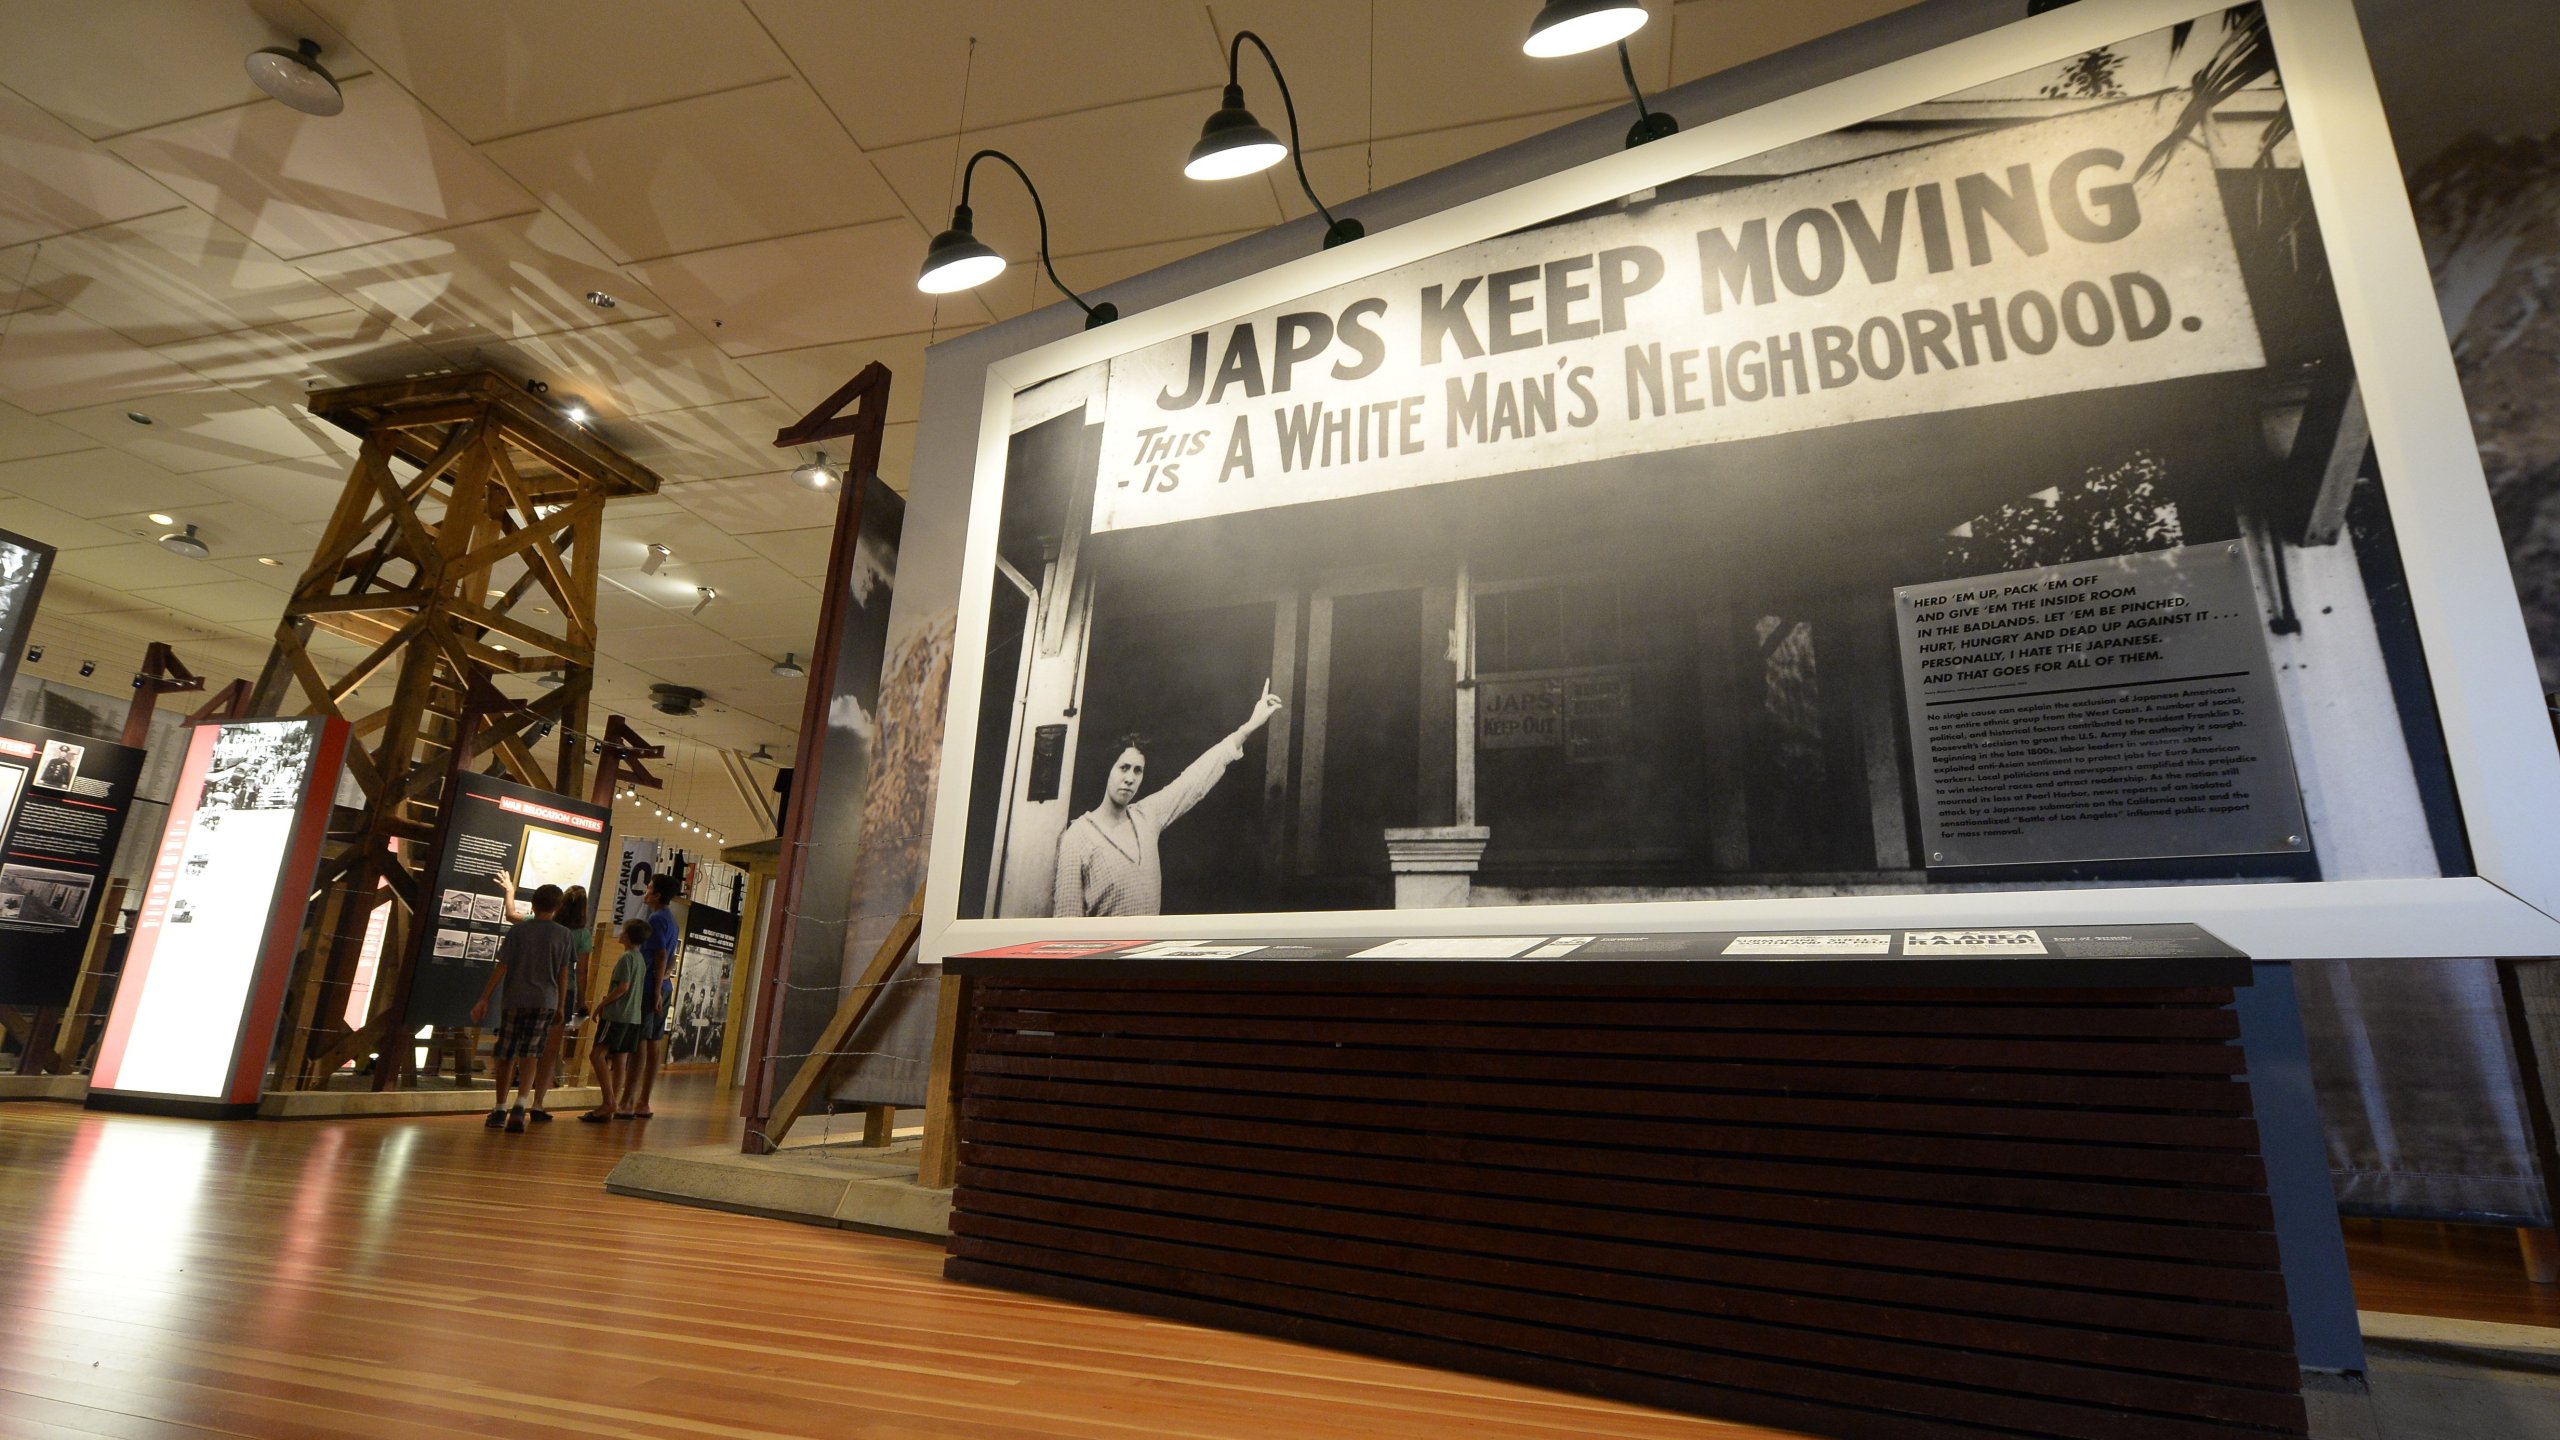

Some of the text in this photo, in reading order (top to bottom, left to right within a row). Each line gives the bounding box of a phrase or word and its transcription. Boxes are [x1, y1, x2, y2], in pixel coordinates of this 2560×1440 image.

[1156, 147, 2142, 411] JAPS KEEP MOVING
[1218, 271, 2202, 483] A WHITE MAN'S NEIGHBORHOOD.
[1134, 425, 1210, 466] THIS
[1913, 575, 2098, 609] HERD 'EM UP, PACK 'EM OFF
[1915, 586, 2136, 624] AND GIVE 'EM THE INSIDE ROOM
[1917, 597, 2190, 639] IN THE BADLANDS. LET 'EM BE PINCHED,
[1919, 610, 2209, 654] HURT, HUNGRY AND DEAD UP AGAINST IT
[1921, 633, 2163, 669] PERSONALLY, I HATE THE JAPANESE.
[1923, 650, 2164, 685] AND THAT GOES FOR ALL OF THEM.
[1487, 692, 1553, 712] JAPS
[1927, 713, 1941, 721] No
[1942, 711, 1969, 720] single
[1970, 709, 1997, 717] cause
[2017, 703, 2052, 713] explain
[2054, 701, 2070, 710] the
[2071, 697, 2117, 708] exclusion
[2119, 695, 2130, 703] of
[2131, 692, 2179, 703] Japanese
[2182, 687, 2237, 698] Americans
[1955, 721, 1981, 729] entire
[1982, 718, 2010, 727] ethnic
[2012, 716, 2041, 726] group
[2042, 713, 2066, 721] from
[2067, 711, 2083, 719] the
[2084, 709, 2110, 718] West
[2156, 701, 2196, 711] number
[2197, 699, 2209, 708] of
[1484, 715, 1556, 736] KEEP OUT
[1969, 730, 1988, 739] and
[1989, 726, 2031, 737] historical
[2033, 725, 2066, 733] factors
[2067, 718, 2123, 730] contributed
[2137, 714, 2185, 725] President
[2187, 709, 2230, 720] Franklin
[1981, 739, 2018, 749] decision
[2032, 736, 2059, 746] grant
[2060, 734, 2076, 742] the
[2100, 731, 2128, 739] Army
[2129, 728, 2146, 736] the
[2148, 724, 2195, 735] authority
[2197, 723, 2205, 731] it
[1933, 763, 1975, 775] exploited
[2026, 757, 2072, 767] sentiment
[2087, 753, 2121, 764] protect
[2124, 751, 2145, 761] jobs
[2146, 750, 2163, 758] for
[2164, 749, 2188, 757] Euro
[2191, 745, 2241, 755] American
[1977, 772, 2001, 782] Local
[2003, 770, 2050, 782] politicians
[2052, 767, 2072, 776] and
[2073, 765, 2134, 775] newspapers
[2135, 759, 2185, 771] amplified
[2186, 758, 2206, 766] this
[2208, 754, 2257, 767] prejudice
[1937, 796, 1978, 806] mourned
[1980, 795, 1991, 803] its
[1993, 795, 2012, 803] loss
[2025, 791, 2051, 800] Pearl
[2121, 786, 2159, 796] reports
[2160, 783, 2172, 792] of
[2190, 779, 2233, 790] isolated
[1947, 786, 1965, 794] win
[1966, 783, 2006, 793] electoral
[2035, 780, 2055, 789] and
[2056, 779, 2089, 787] attract
[2150, 773, 2163, 781] As
[2165, 771, 2182, 780] the
[2184, 770, 2219, 779] nation
[2221, 767, 2240, 776] still
[522, 804, 570, 823] RELOCATION
[571, 817, 601, 830] CENTERS
[1940, 830, 1955, 839] for
[613, 850, 634, 925] MANZANAR
